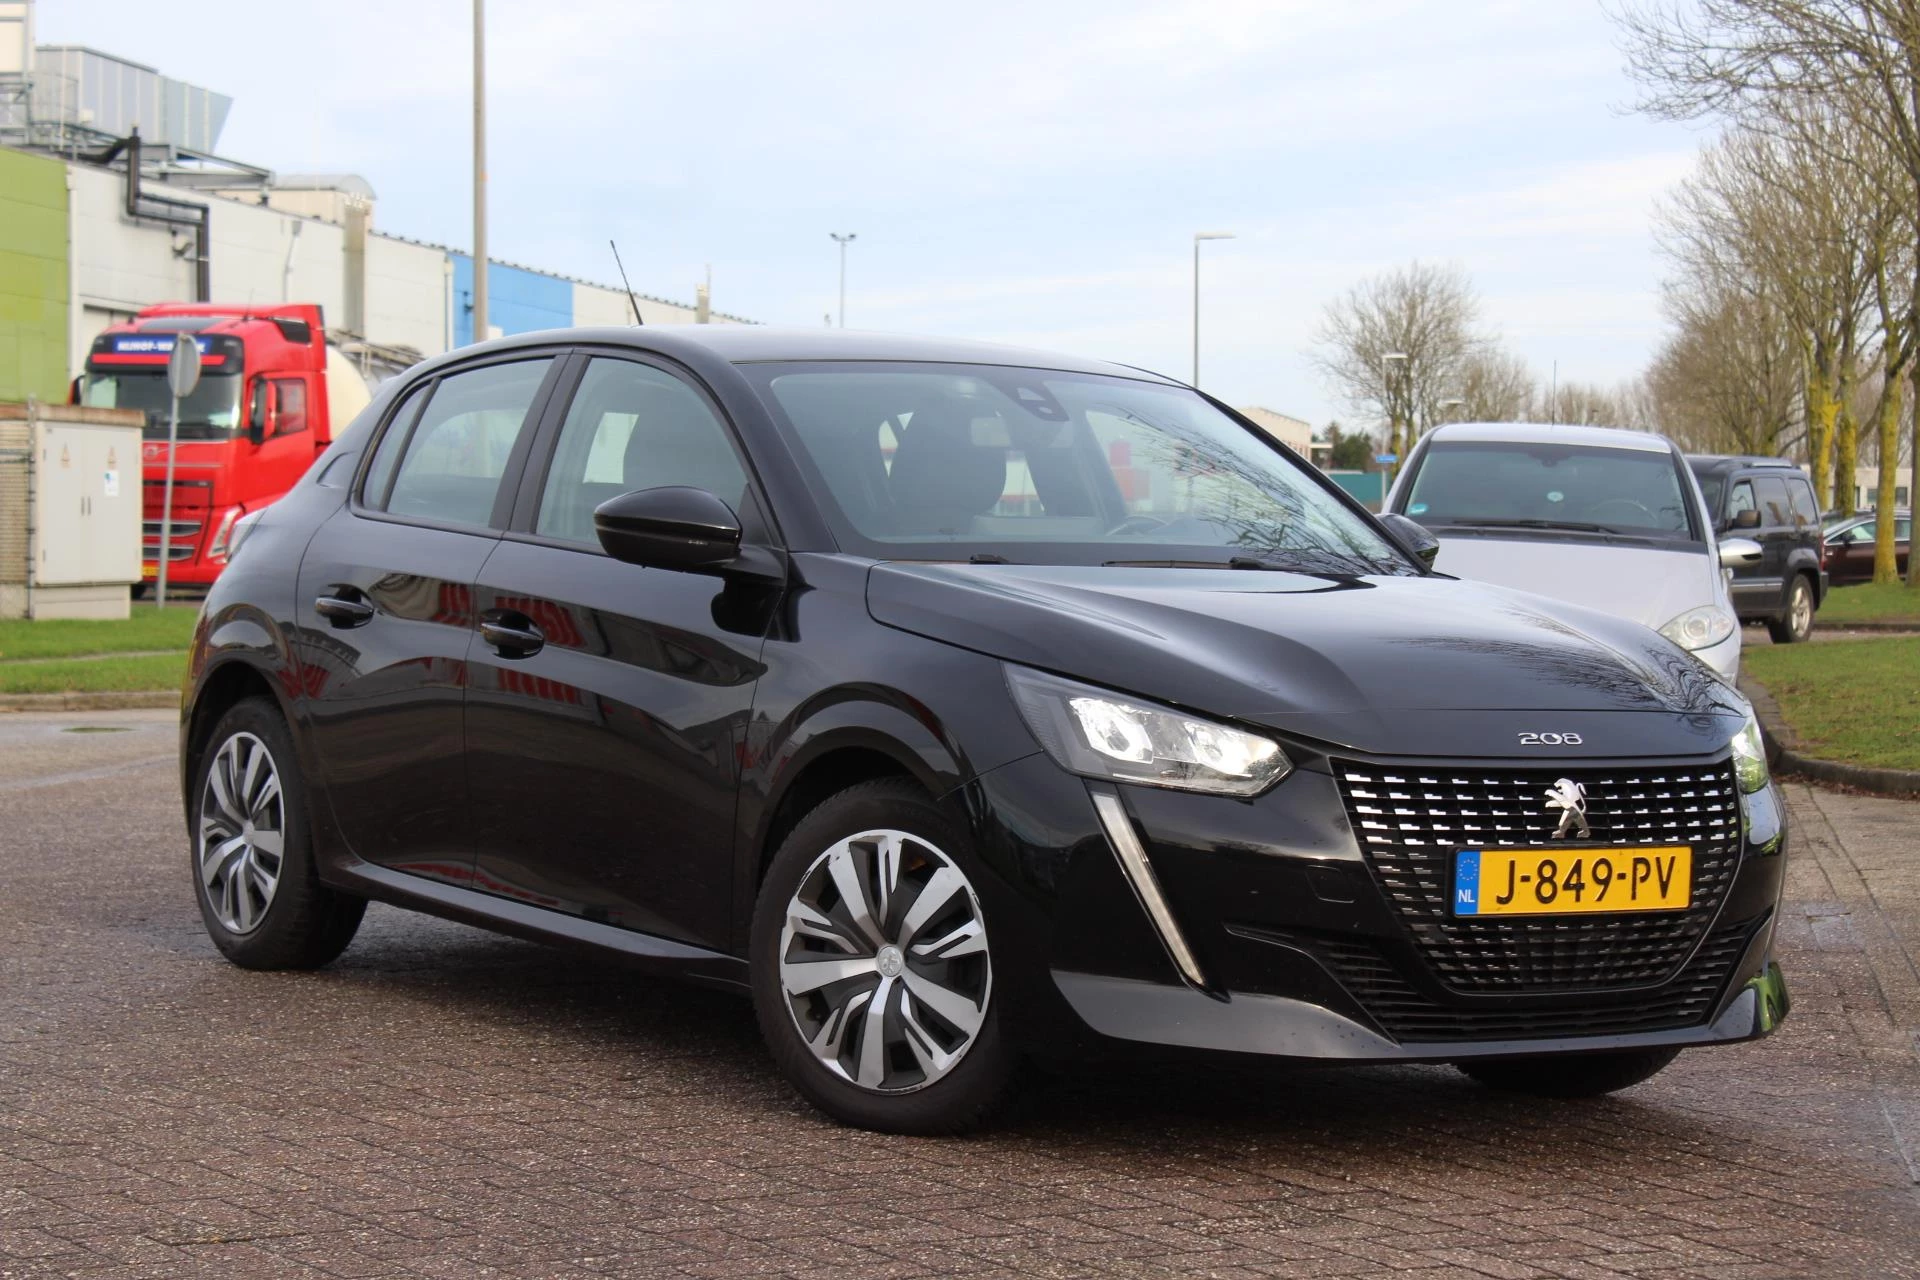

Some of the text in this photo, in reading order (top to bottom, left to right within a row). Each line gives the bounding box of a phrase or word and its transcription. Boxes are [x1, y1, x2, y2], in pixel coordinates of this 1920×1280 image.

[1517, 732, 1583, 745] 208
[1496, 856, 1676, 905] J-849-PV
[1458, 889, 1475, 903] NL
